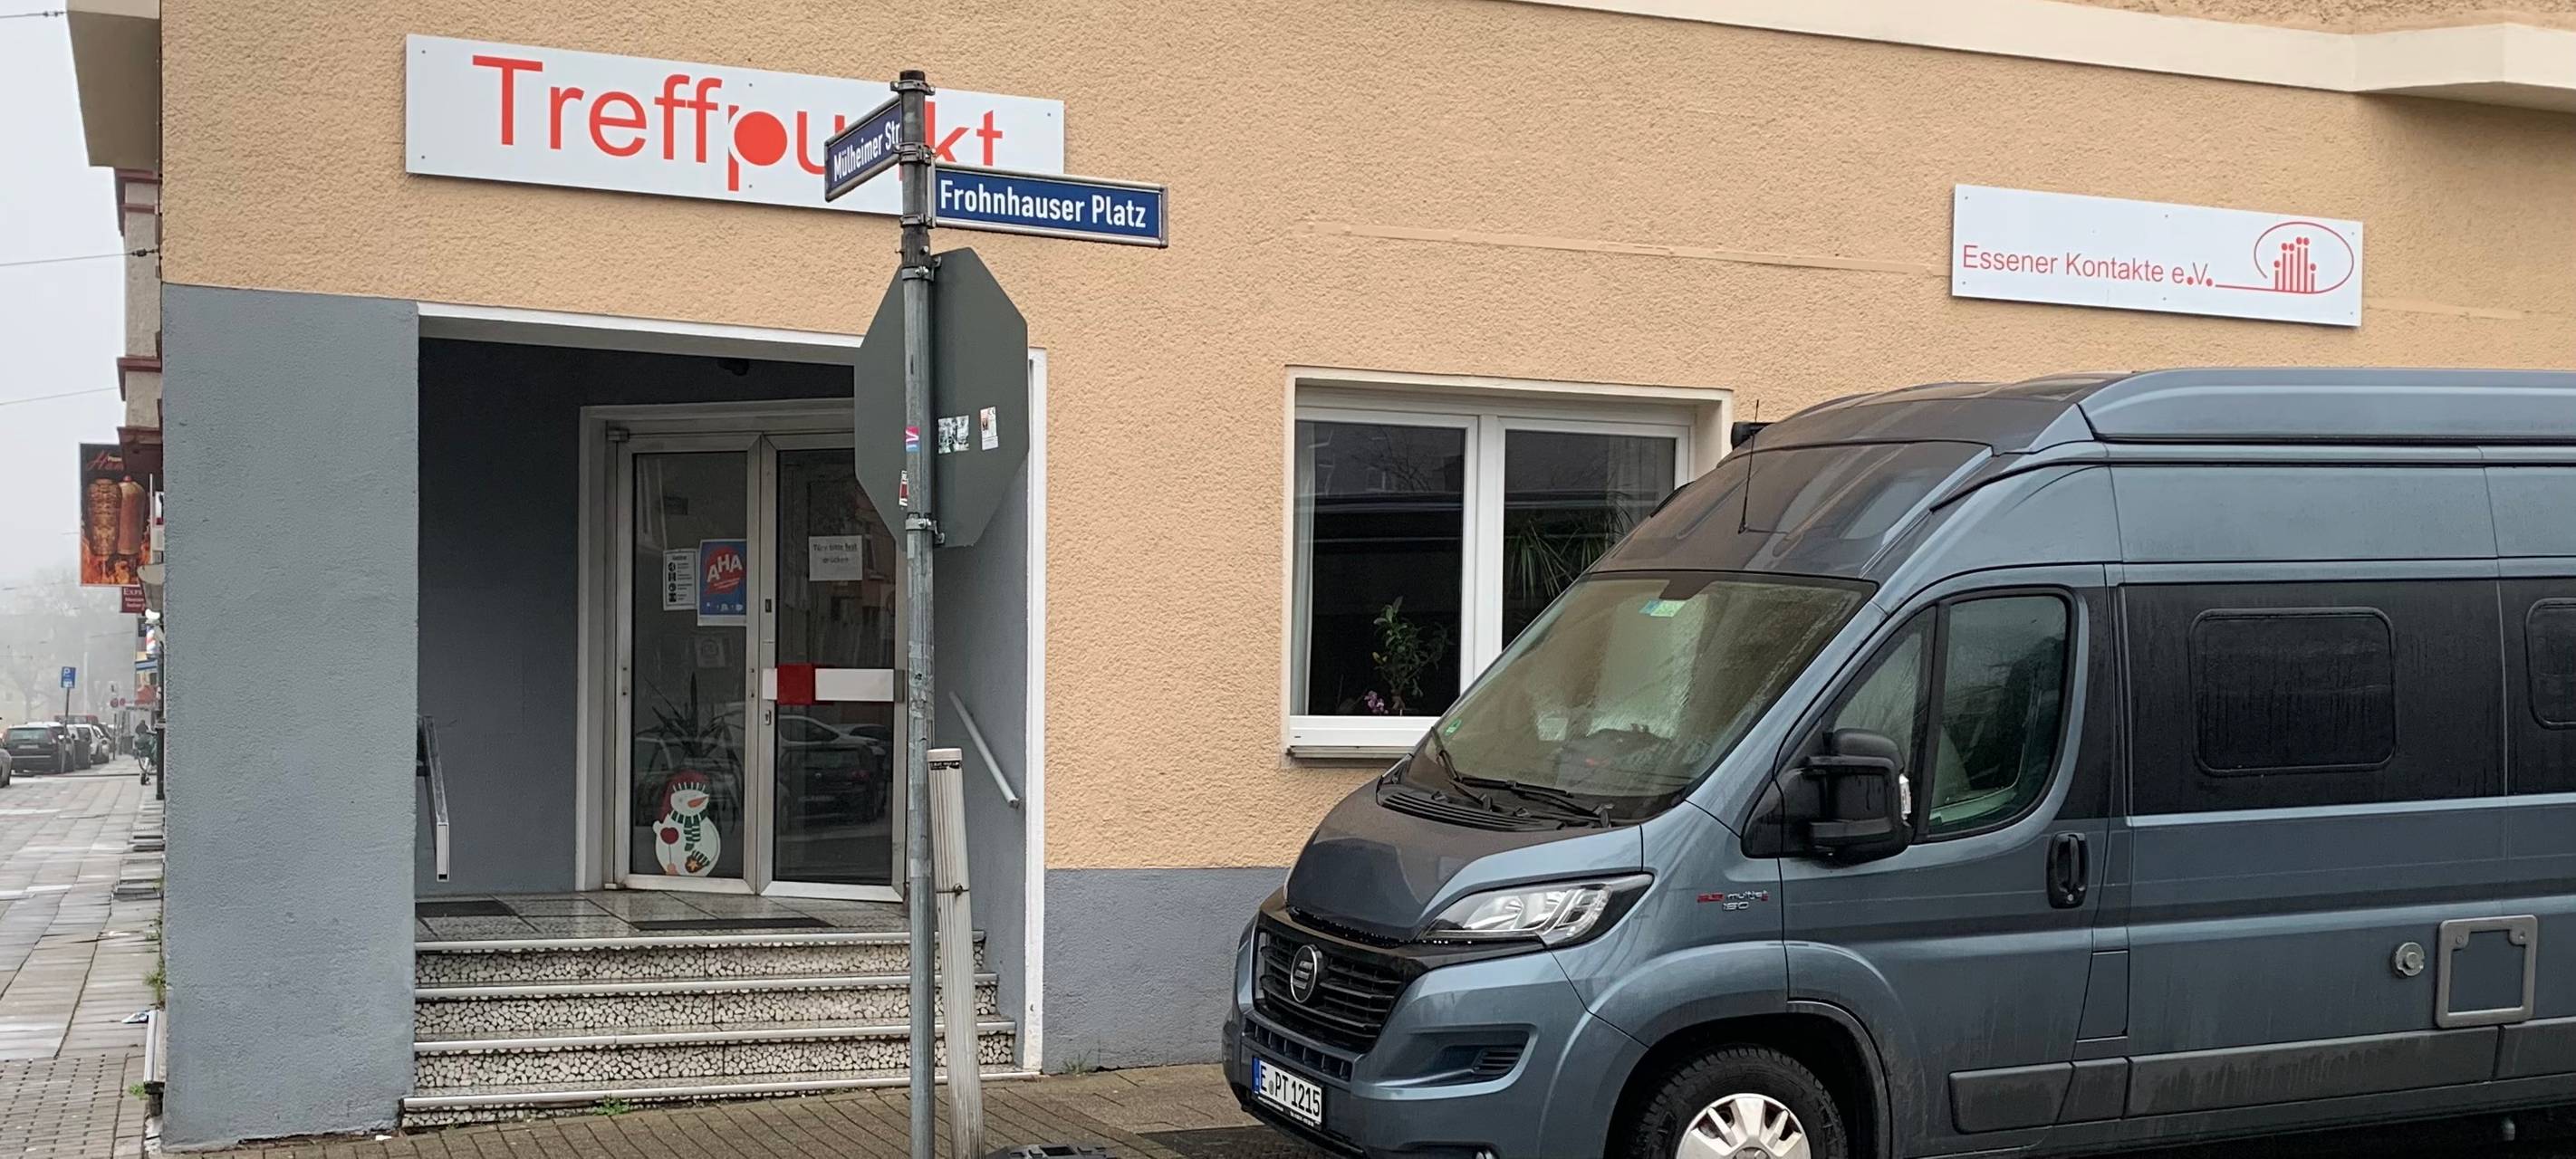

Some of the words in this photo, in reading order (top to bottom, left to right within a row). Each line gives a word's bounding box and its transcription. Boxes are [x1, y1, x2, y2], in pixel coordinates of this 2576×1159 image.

[473, 54, 1003, 191] Treffpukt
[833, 134, 883, 182] Mülheimer
[940, 179, 1085, 223] Frohnhauser
[1091, 194, 1147, 229] Platz
[1963, 244, 2058, 274] Essener
[2065, 252, 2164, 283] Kontakte
[2172, 262, 2214, 286] e.V.
[706, 553, 743, 583] AHA
[1260, 1064, 1267, 1093] E
[1274, 1070, 1289, 1102] PT
[1291, 1079, 1321, 1117] 1215
